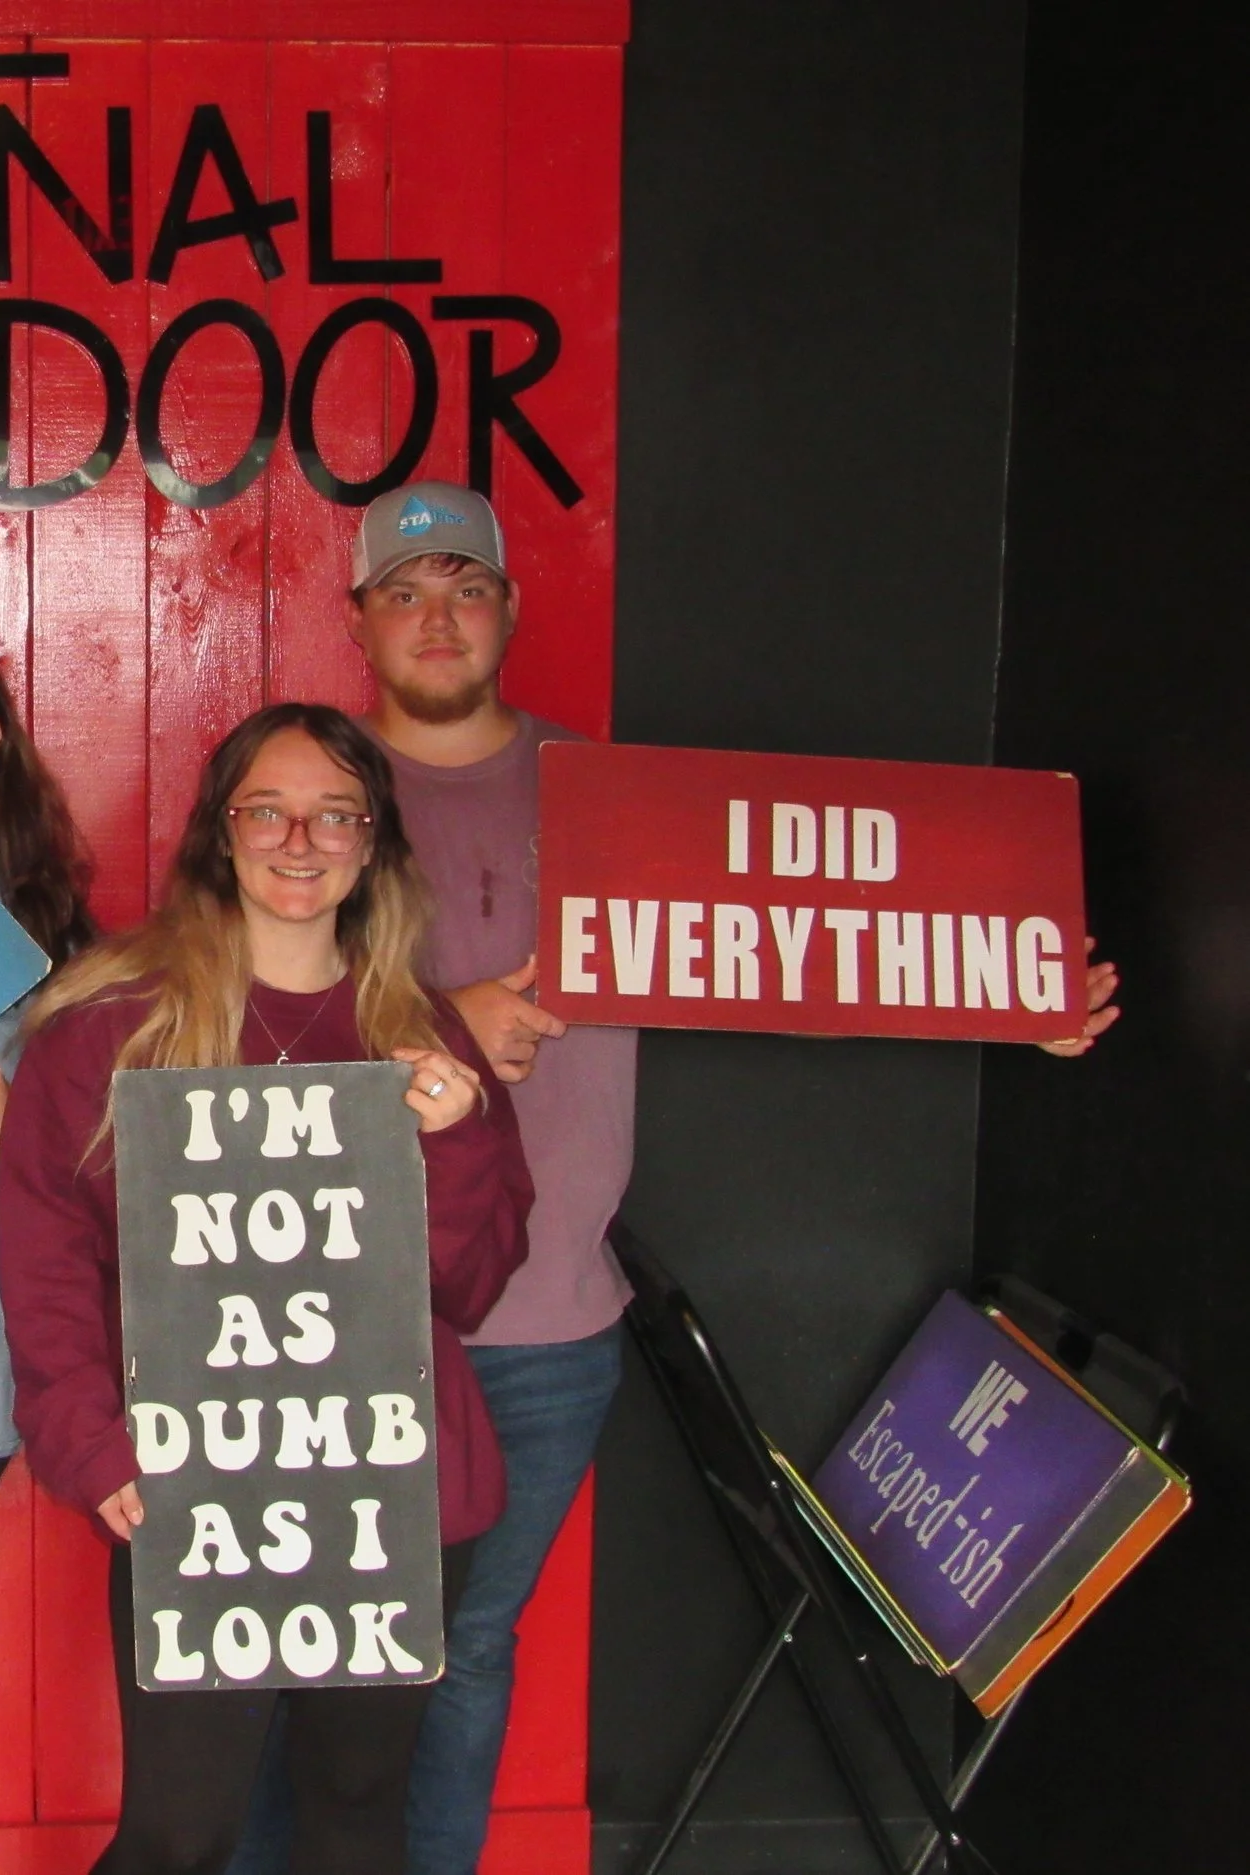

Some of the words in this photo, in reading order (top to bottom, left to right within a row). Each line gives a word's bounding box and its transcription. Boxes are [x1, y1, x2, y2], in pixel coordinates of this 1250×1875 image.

[728, 800, 749, 874] I
[772, 803, 898, 882] DID
[561, 897, 1065, 1012] EVERYTHING
[184, 1085, 343, 1161] I'M
[170, 1187, 364, 1265] NOT
[206, 1292, 336, 1367] AS
[130, 1394, 427, 1474] DUMB
[949, 1360, 1029, 1457] WE
[179, 1501, 312, 1576] AS
[350, 1499, 389, 1570] I
[848, 1400, 1024, 1609] Escaped-ish
[152, 1602, 423, 1682] LOOK
